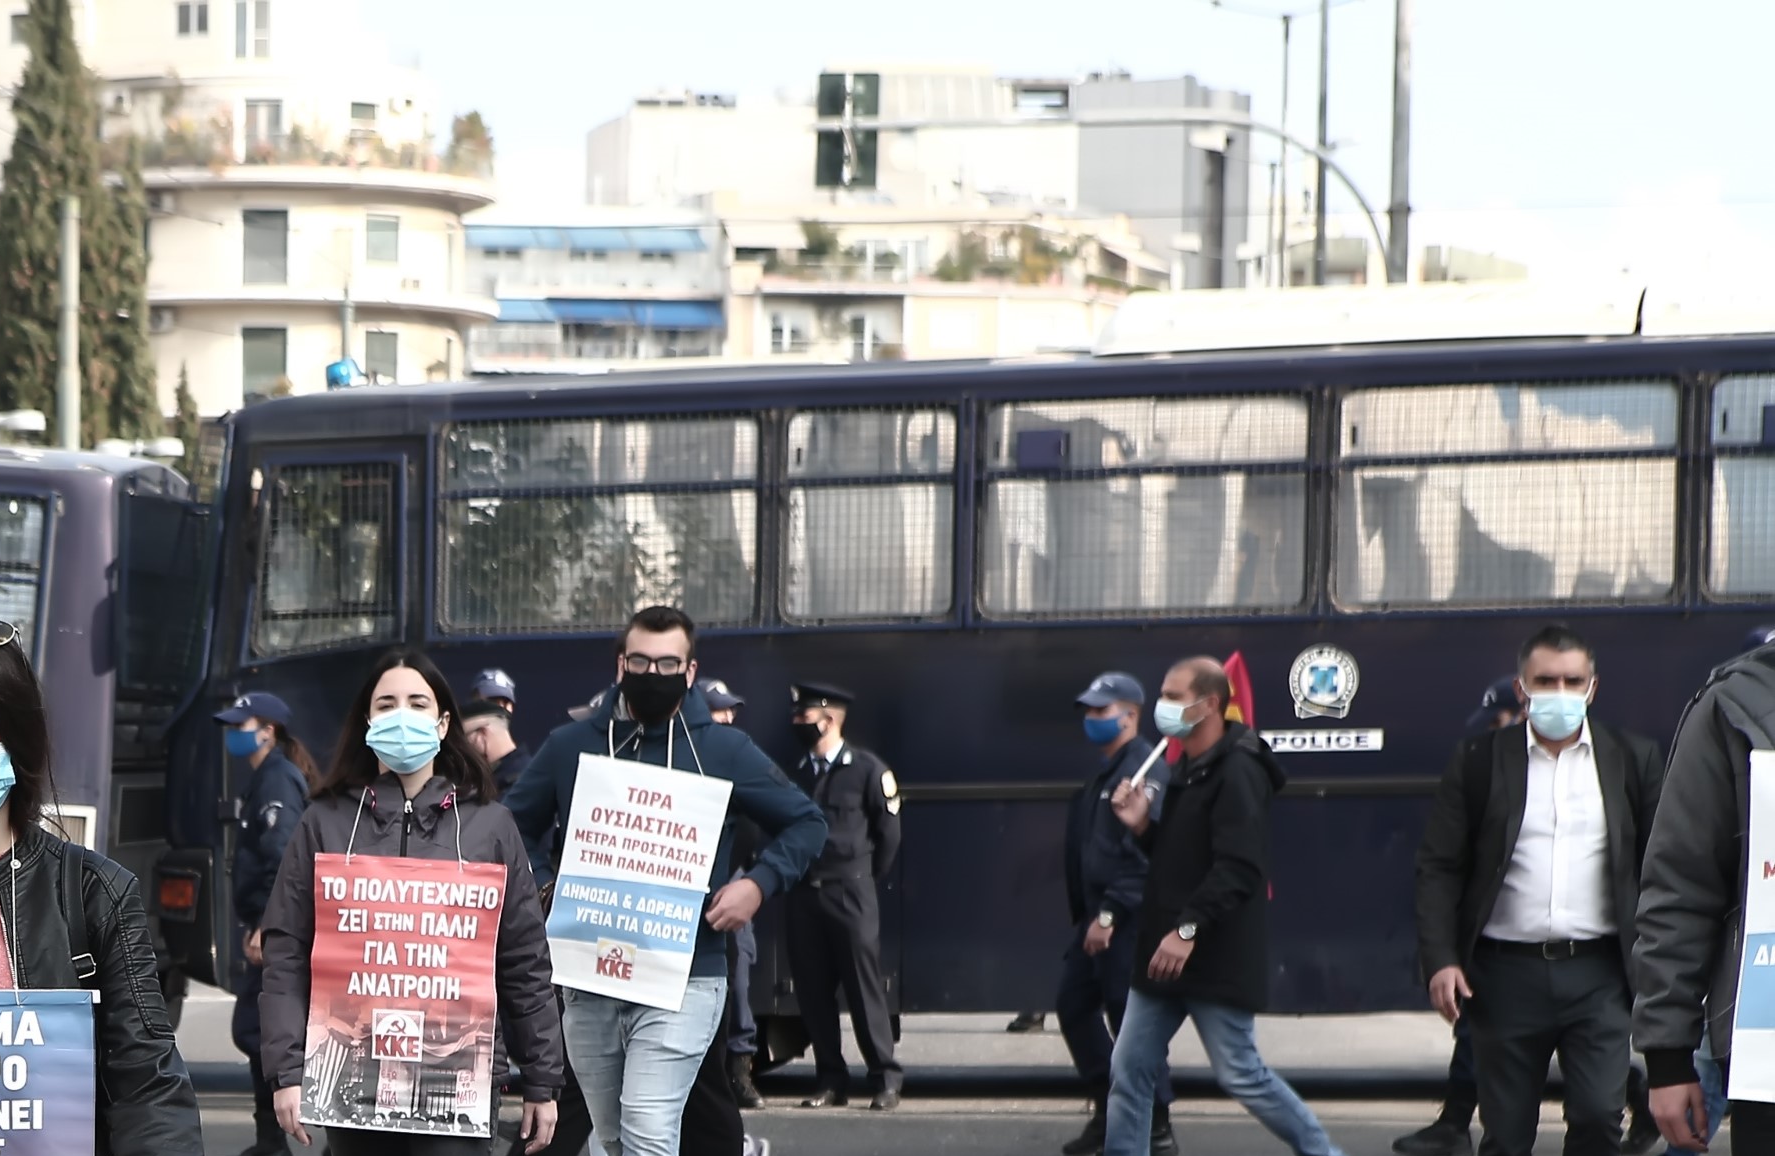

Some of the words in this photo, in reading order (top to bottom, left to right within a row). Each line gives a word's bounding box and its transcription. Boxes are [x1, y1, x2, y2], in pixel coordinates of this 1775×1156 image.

[1271, 736, 1369, 749] POLICE
[628, 786, 672, 810] ΤΩΡΑ
[591, 807, 697, 843] ΟΥΣΙΑΣΤΙΚΑ
[574, 828, 617, 848] ΜΕΤΡΑ
[622, 838, 708, 867] ΠΡΟΣΤΑΣΙΑΣ
[580, 849, 612, 868] ΣΤΗΝ
[617, 857, 692, 884] ΠΑΝΔΗΜΙΑ
[321, 876, 346, 900] ΤΟ
[353, 877, 499, 910] ΠΟΛΥΤΕΧΝΕΙΟ
[561, 883, 618, 907] ΔΗΜΟΣΙΑ
[623, 894, 632, 910] &
[636, 897, 693, 922] ΔΩΡΕΑΝ
[337, 909, 368, 932] ΖΕΙ
[374, 911, 414, 932] ΣΤΗΝ
[420, 912, 478, 939] ΠΑΛΗ
[576, 907, 613, 927] ΥΓΕΙΑ
[616, 916, 638, 933] ΓΙΑ
[643, 922, 689, 943] ΟΛΟΥΣ
[363, 941, 398, 965] ΓΙΑ
[404, 943, 448, 968] ΤΗΝ
[596, 957, 633, 980] ΚΚΕ
[347, 972, 461, 1000] ΑΝΑΤΡΟΠΗ
[375, 1034, 420, 1057] ΚΚΕ
